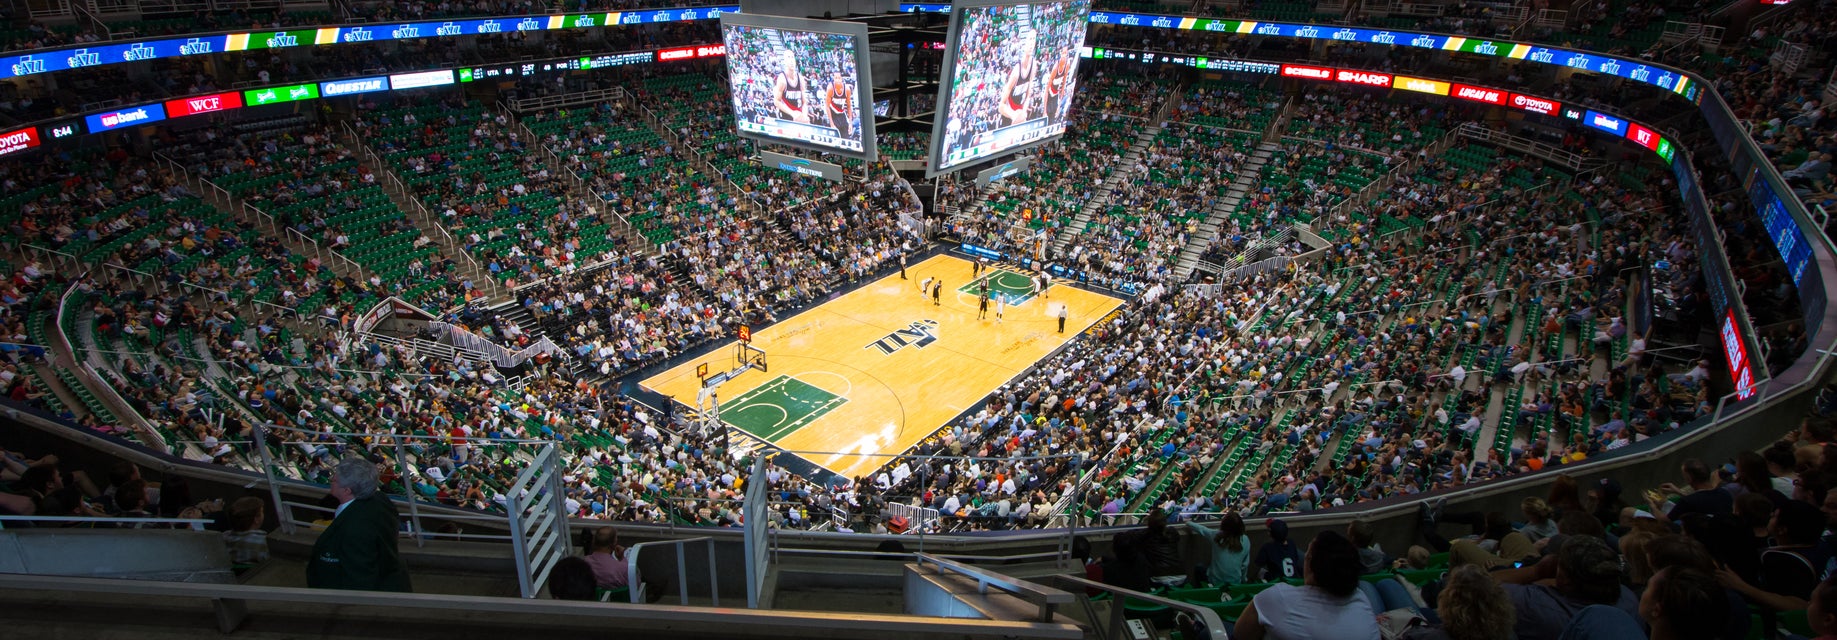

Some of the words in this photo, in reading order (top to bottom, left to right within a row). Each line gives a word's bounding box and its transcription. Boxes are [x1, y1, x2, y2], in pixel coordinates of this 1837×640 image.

[267, 32, 298, 47] JAZZ
[344, 27, 373, 42] JAZZ
[123, 43, 156, 61] JAZZ
[180, 38, 212, 55] JAZZ
[698, 46, 725, 57] SHAR
[12, 55, 46, 75] JAZZ
[68, 49, 101, 67] JAZZ
[522, 64, 535, 72] 2:57
[1338, 71, 1389, 84] SHARP
[325, 80, 382, 94] QUESTAR
[1458, 87, 1486, 100] LUCAS
[1485, 91, 1499, 102] OIL
[189, 98, 219, 111] WCF
[1526, 98, 1553, 110] TOYOTA
[53, 126, 72, 137] 8:44
[1637, 130, 1651, 144] WCF
[0, 132, 31, 148] OYOTA
[863, 319, 939, 356] JAZZ
[1283, 557, 1294, 577] 6
